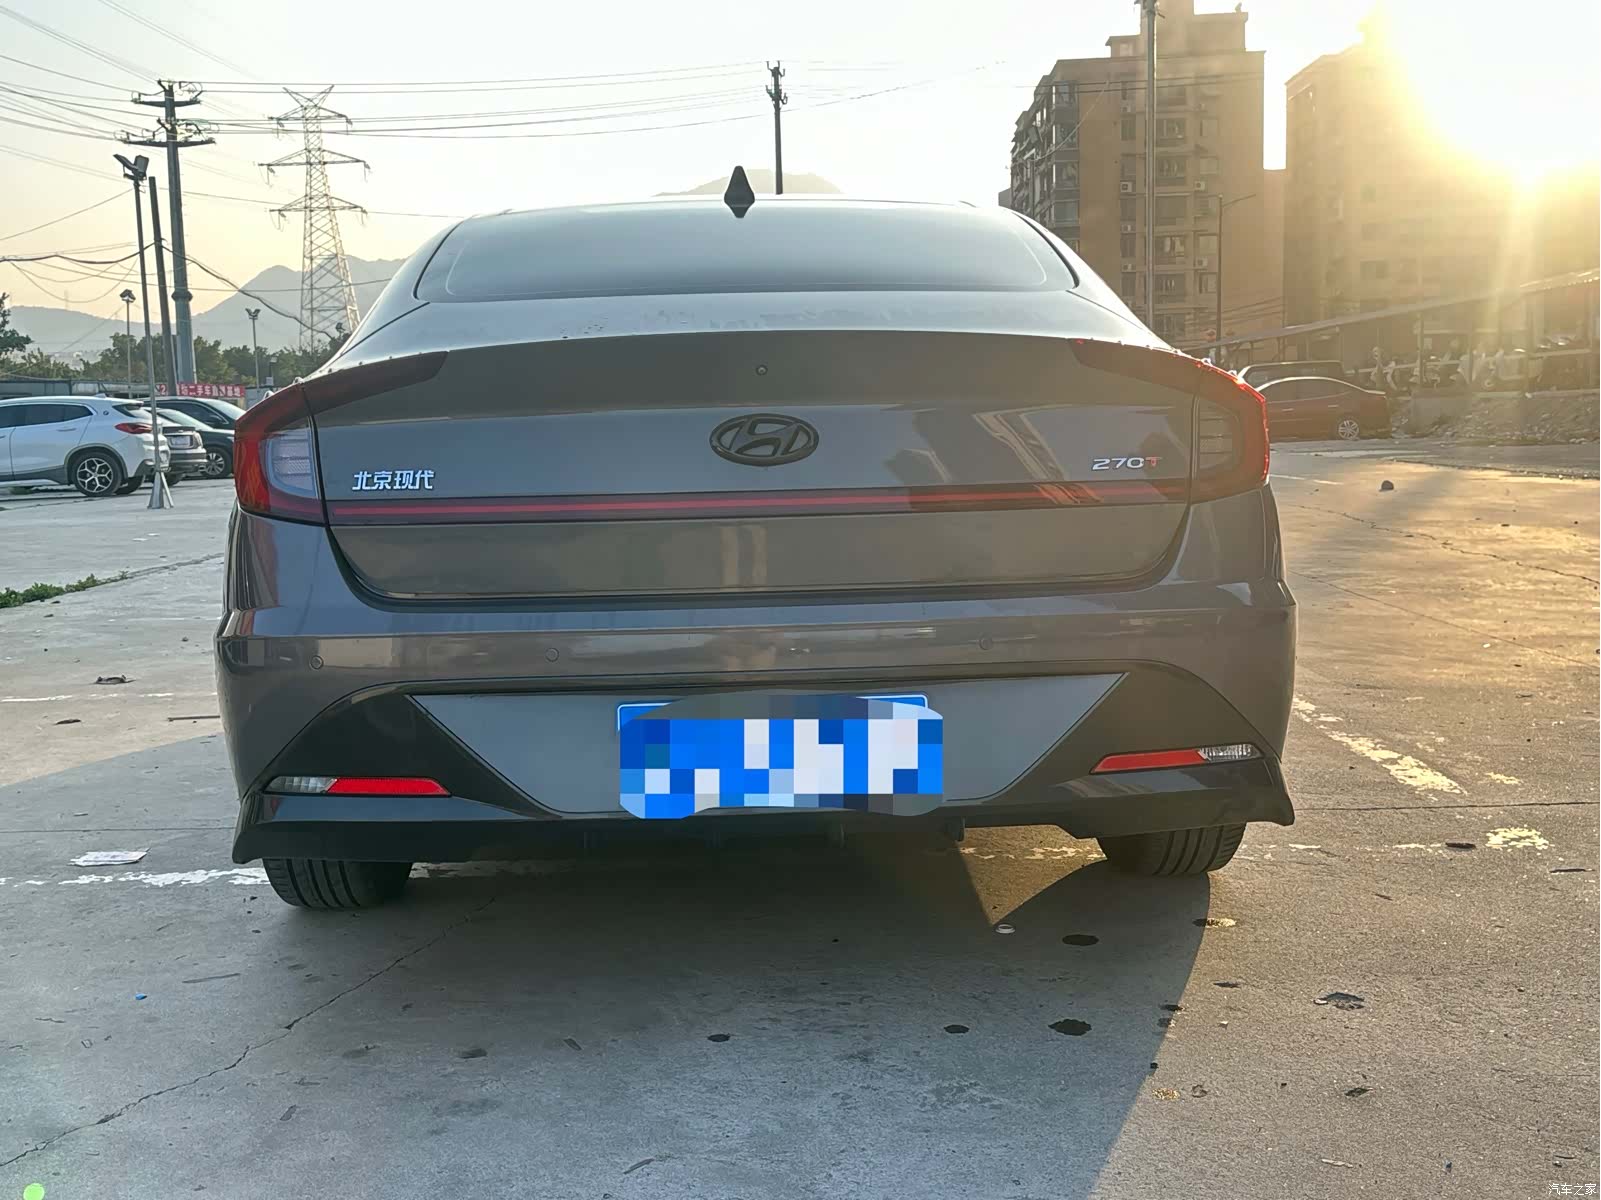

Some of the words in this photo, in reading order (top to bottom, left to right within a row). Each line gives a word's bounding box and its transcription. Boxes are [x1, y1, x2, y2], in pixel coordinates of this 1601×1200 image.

[1092, 456, 1162, 470] 270T
[352, 470, 434, 490] 北京现代
